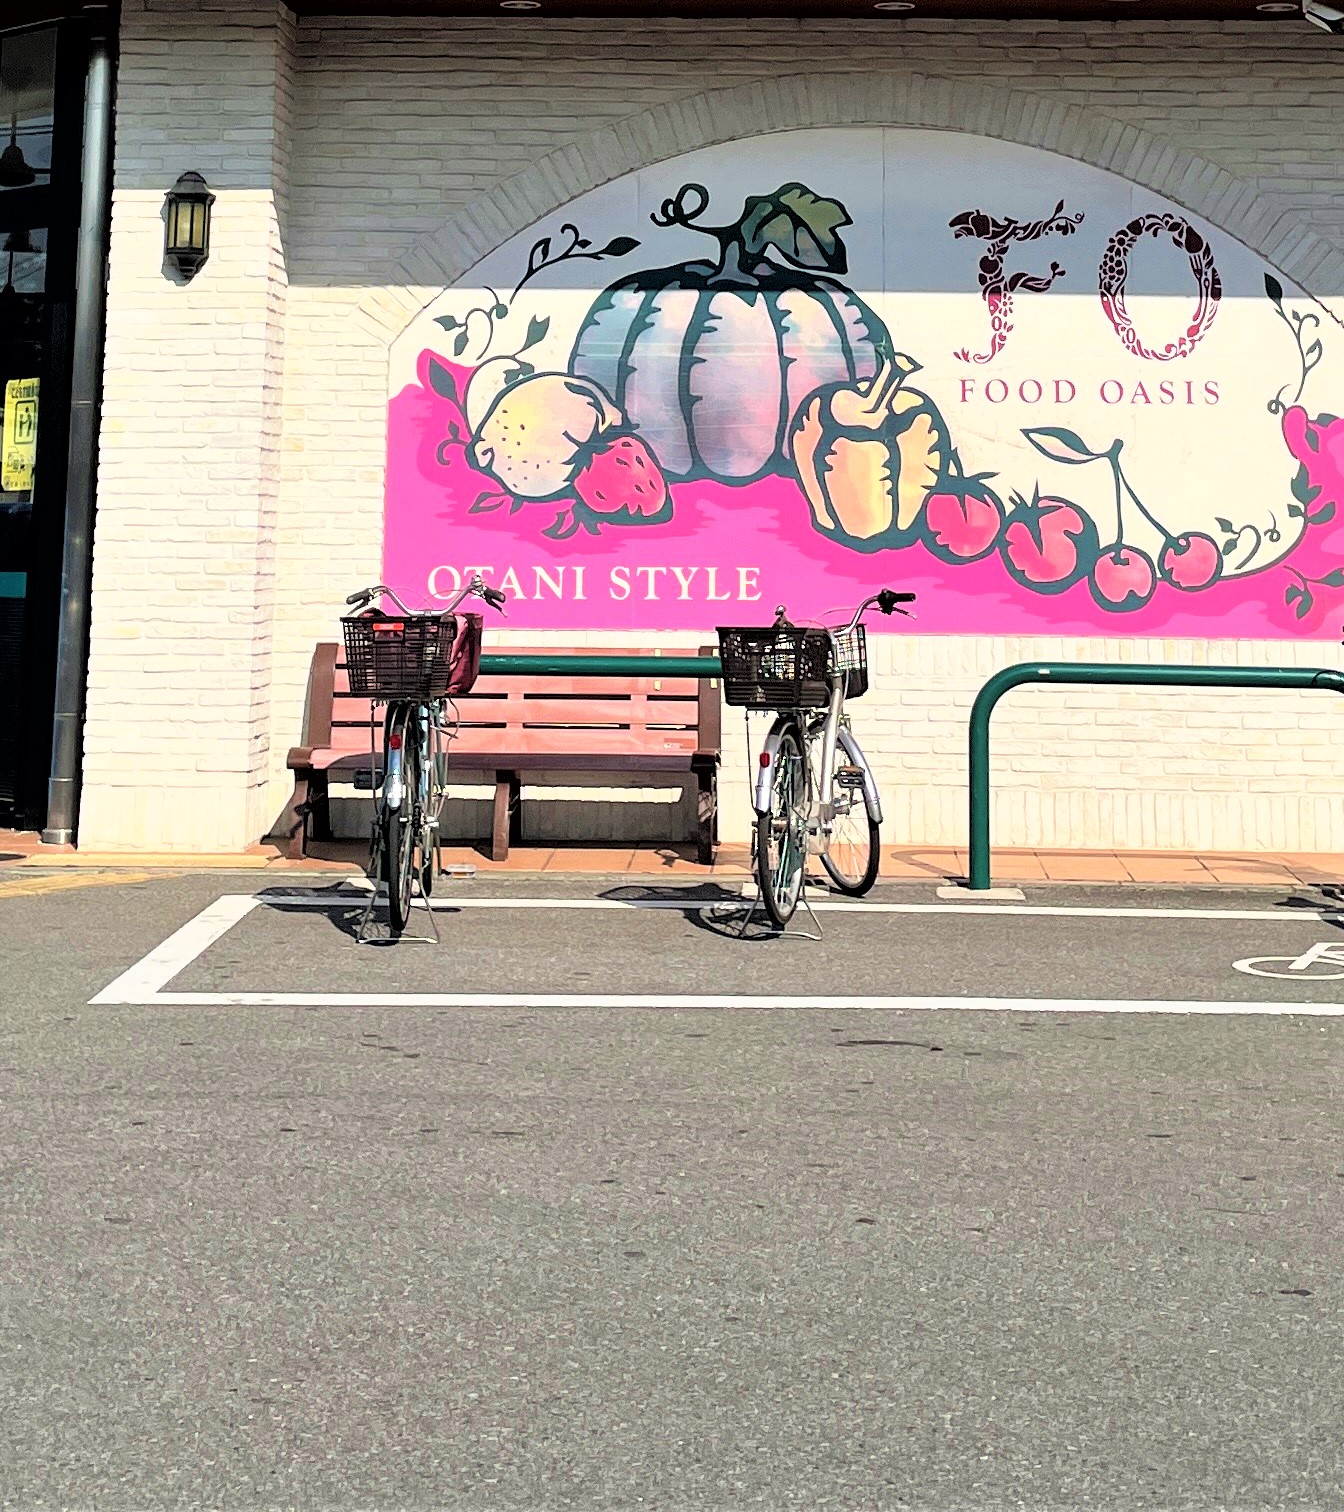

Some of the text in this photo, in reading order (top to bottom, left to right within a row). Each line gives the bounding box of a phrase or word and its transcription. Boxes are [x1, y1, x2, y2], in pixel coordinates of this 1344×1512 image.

[959, 378, 1220, 406] FOOD OASIS
[427, 565, 763, 602] OTANI STYLE
